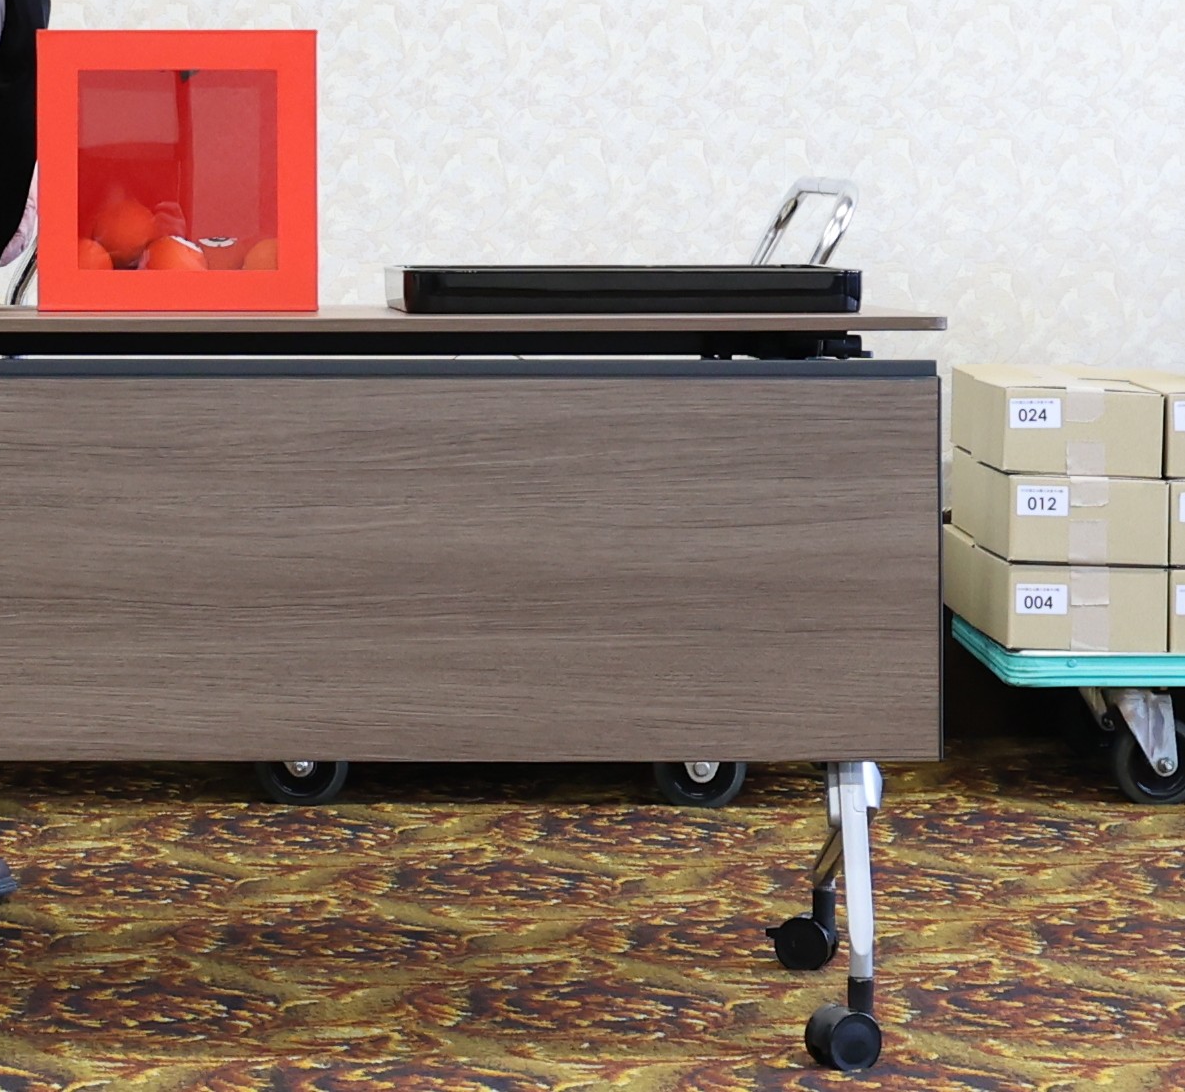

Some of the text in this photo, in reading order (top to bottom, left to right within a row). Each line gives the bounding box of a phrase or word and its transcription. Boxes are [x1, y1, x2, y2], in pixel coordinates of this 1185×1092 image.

[1018, 408, 1047, 423] 024
[1027, 496, 1057, 511] 012
[1024, 595, 1053, 610] 004
